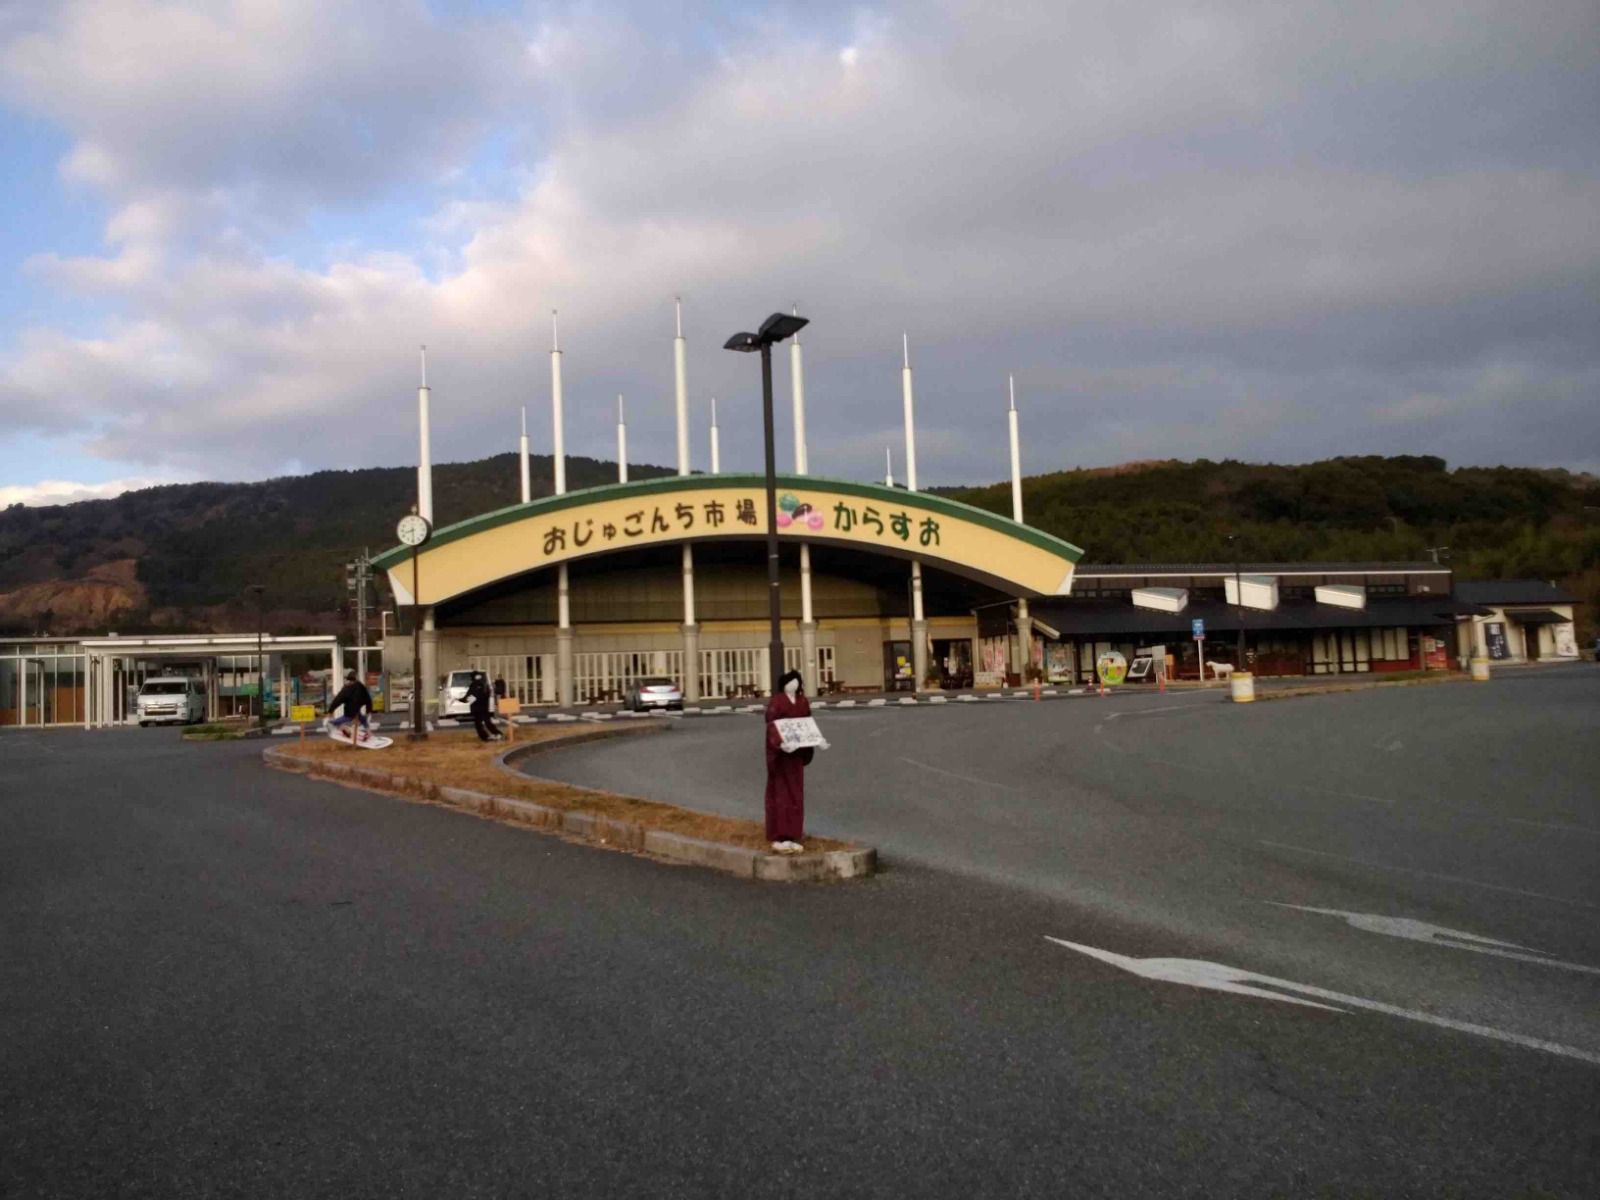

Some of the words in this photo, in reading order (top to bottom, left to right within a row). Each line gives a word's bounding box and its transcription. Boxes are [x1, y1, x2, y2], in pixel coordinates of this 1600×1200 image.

[543, 498, 758, 555] おじゅごんち市場
[833, 501, 940, 546] からすお
